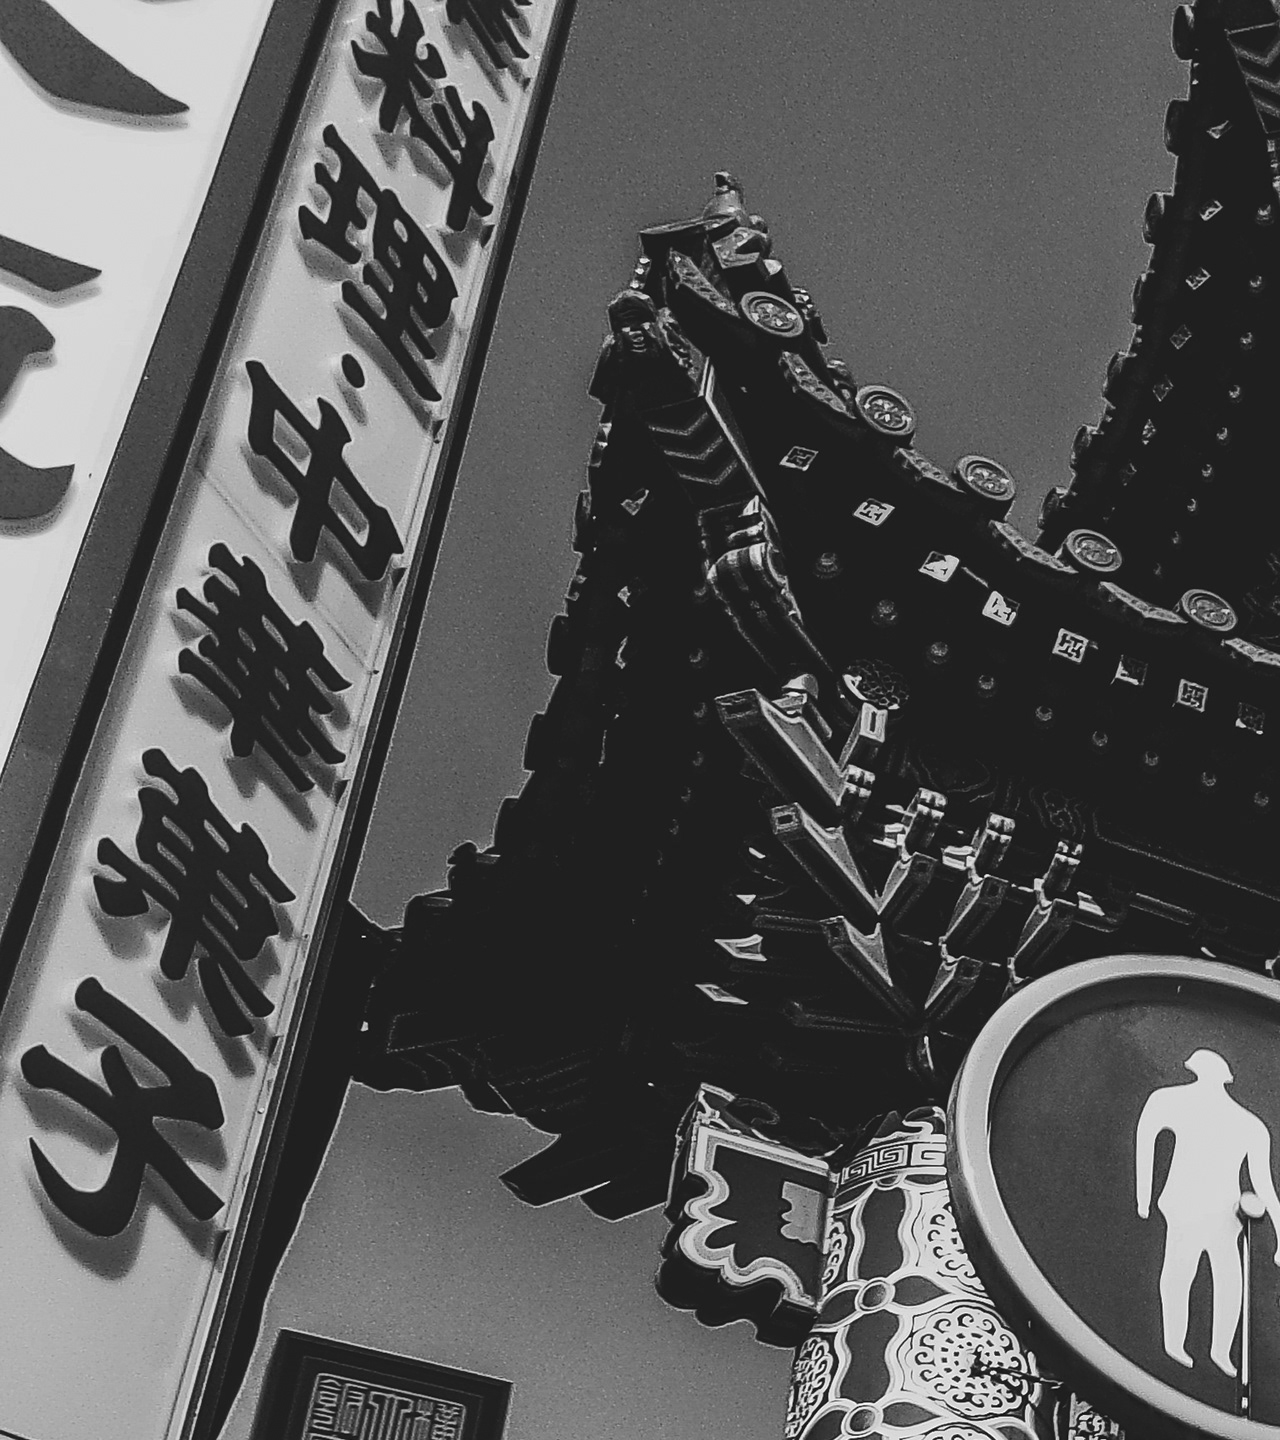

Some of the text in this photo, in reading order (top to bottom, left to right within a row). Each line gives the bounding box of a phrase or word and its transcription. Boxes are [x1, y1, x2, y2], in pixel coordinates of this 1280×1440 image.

[21, 0, 531, 1237] 料理・中華菓子
